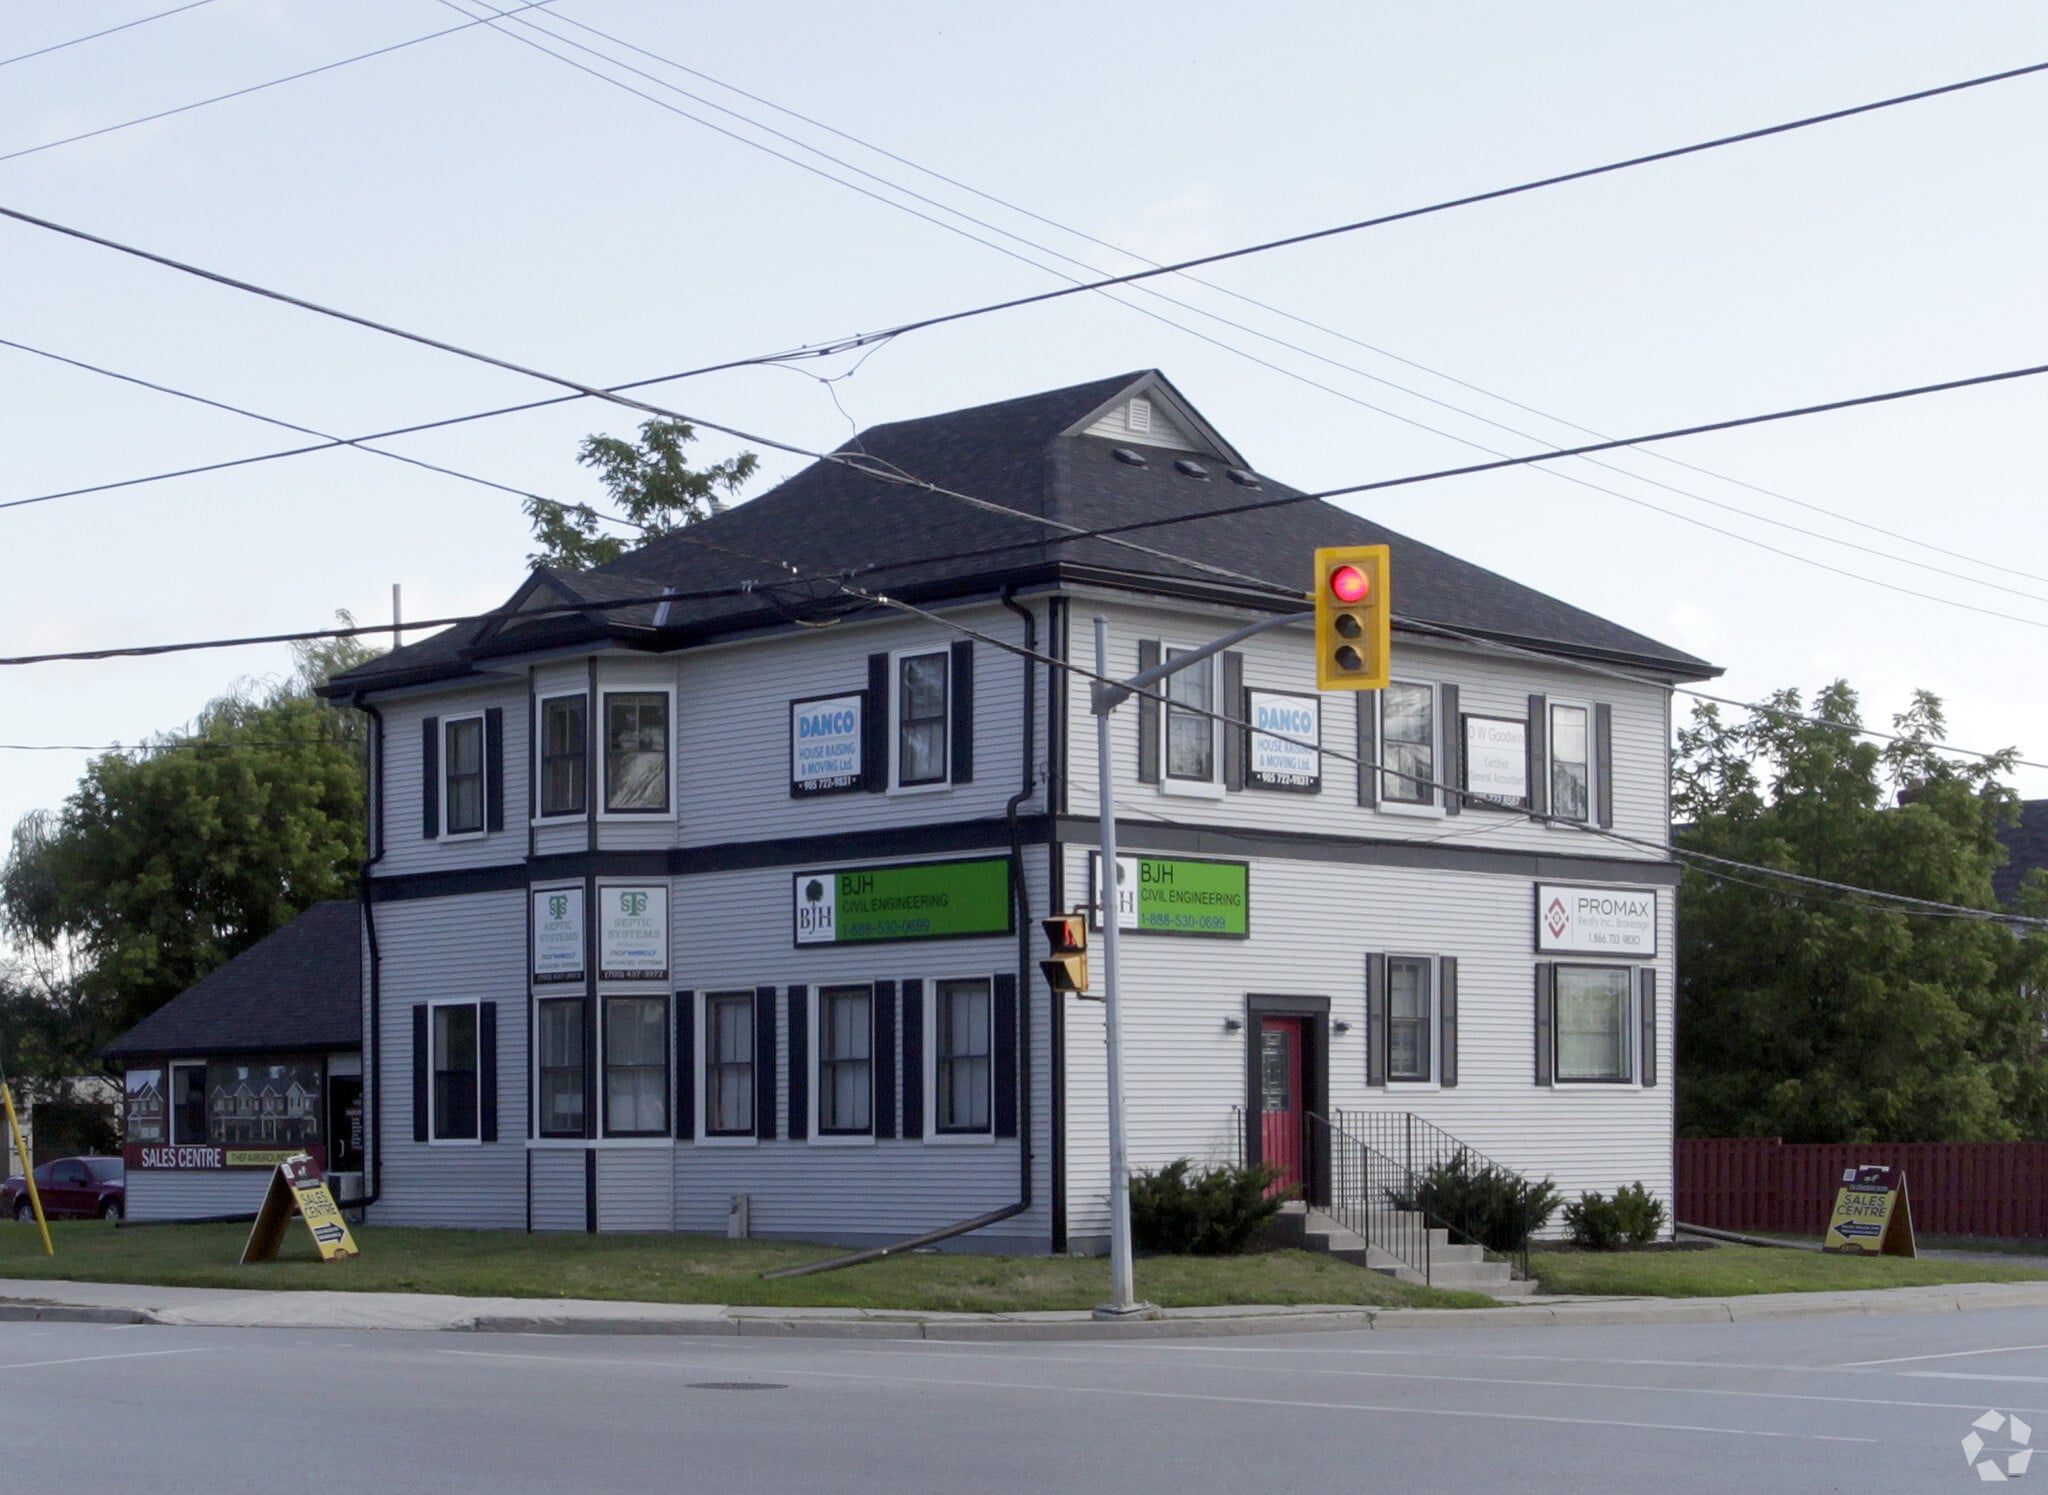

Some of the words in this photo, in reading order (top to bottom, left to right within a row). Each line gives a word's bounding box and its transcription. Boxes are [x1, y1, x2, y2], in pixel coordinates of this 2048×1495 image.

[799, 710, 855, 738] DANCO
[1257, 706, 1313, 734] DANCO
[1478, 727, 1487, 741] W
[800, 745, 824, 761] HOUSE
[826, 742, 856, 756] RAISING
[1257, 738, 1283, 752] HOUSE
[808, 759, 839, 775] MOVING
[1266, 754, 1298, 771] MOVING
[1141, 863, 1174, 885] BJH
[842, 875, 874, 897] BJH
[842, 898, 869, 914] CIVIL
[872, 893, 949, 912] ENGINEERING
[1141, 888, 1167, 903] CIVIL
[1169, 890, 1241, 907] ENGINEERING
[1578, 898, 1649, 918] PROMAX
[544, 920, 572, 931] SEPTIC
[614, 918, 653, 928] SEPTIC
[800, 906, 832, 934] BJH
[1578, 916, 1599, 928] Realty
[1616, 918, 1650, 931] Brokerage
[539, 931, 578, 944] SYSTEMS
[607, 929, 660, 939] SYSTEMS
[142, 1147, 176, 1168] SALES
[178, 1148, 222, 1168] CENTRE
[300, 1189, 328, 1205] SALES
[1843, 1194, 1885, 1207] SALES
[305, 1202, 337, 1219] CENTRE
[1837, 1204, 1888, 1218] CENTRE
